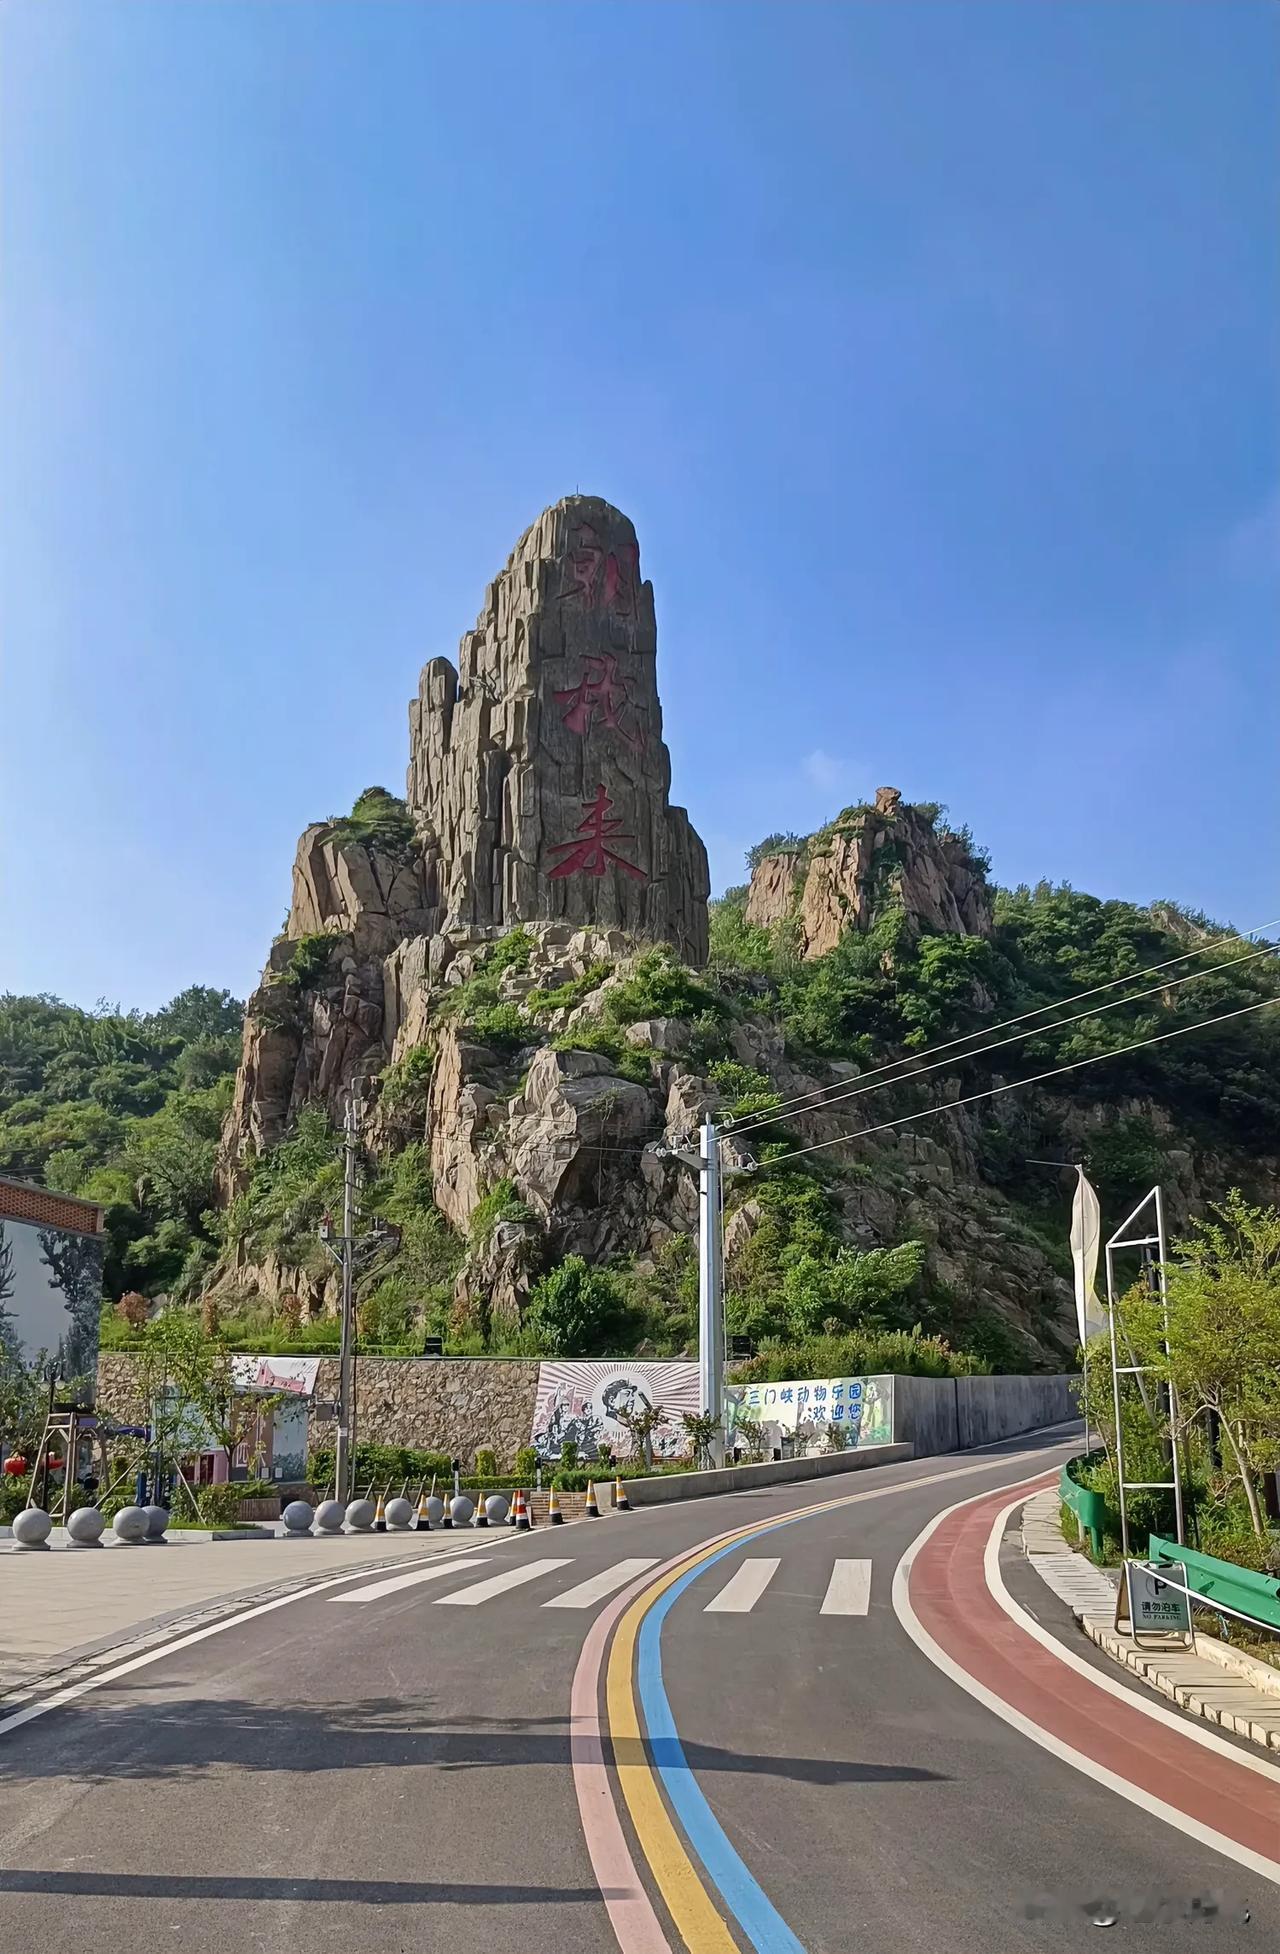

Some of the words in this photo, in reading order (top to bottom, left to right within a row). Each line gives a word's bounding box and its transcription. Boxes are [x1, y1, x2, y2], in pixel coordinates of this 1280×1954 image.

[748, 1382, 863, 1406] 三门峡动物乐园
[813, 1403, 862, 1421] 欢迎您
[1141, 1601, 1181, 1612] 请勿泊车
